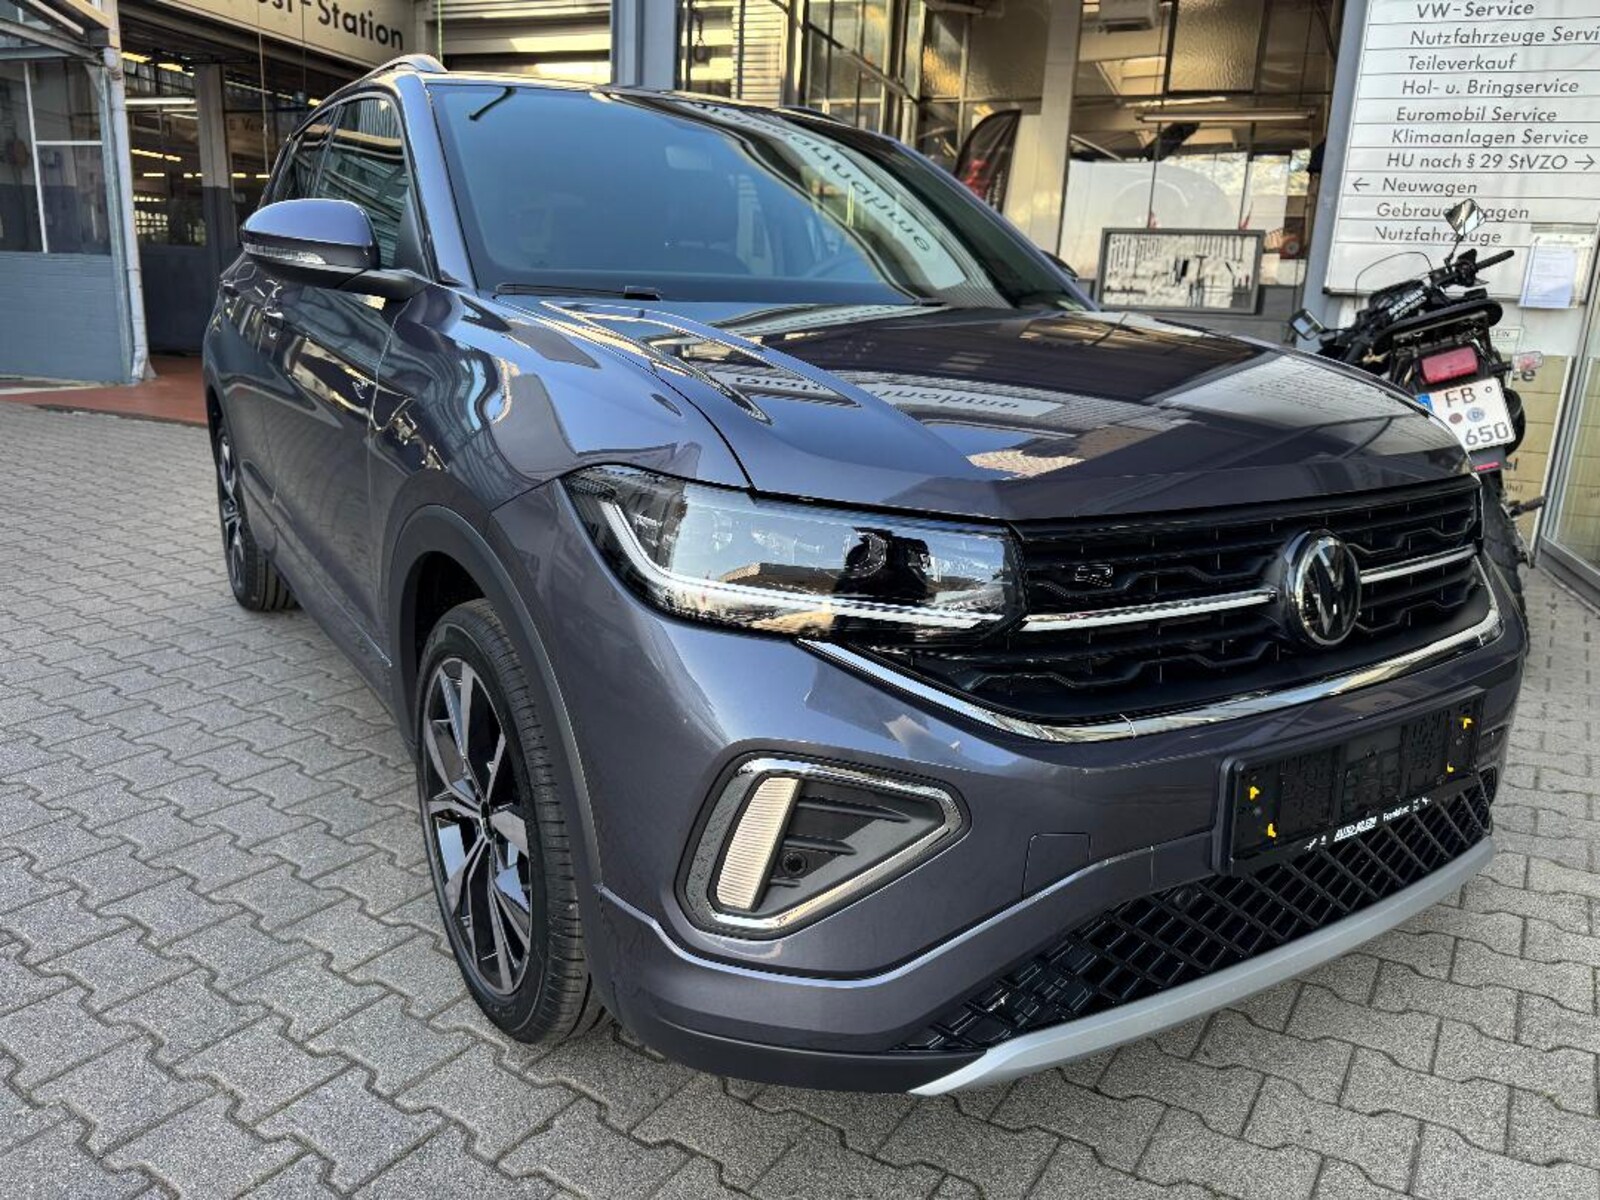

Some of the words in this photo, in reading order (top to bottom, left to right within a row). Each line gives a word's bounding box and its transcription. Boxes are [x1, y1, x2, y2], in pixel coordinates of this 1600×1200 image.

[1417, 2, 1535, 19] VW-Service
[1410, 28, 1545, 47] Nutzfahrzeuge
[1408, 53, 1518, 71] Teileverkauf
[1402, 79, 1440, 95] Hol-
[1446, 83, 1460, 95] u.
[1467, 79, 1579, 98] Bringservice
[1396, 106, 1486, 122] Euromobil
[1492, 106, 1557, 122] Service
[1391, 128, 1515, 147] Klimaanlagen
[1522, 128, 1588, 145] Service
[1387, 153, 1414, 168] HU
[1420, 153, 1462, 169] nach
[1467, 153, 1475, 170] §
[1480, 153, 1502, 169] 29
[1508, 154, 1568, 170] StVZO
[1382, 177, 1477, 197] Neuwagen
[1444, 387, 1477, 408] FB
[1464, 421, 1509, 446] 650
